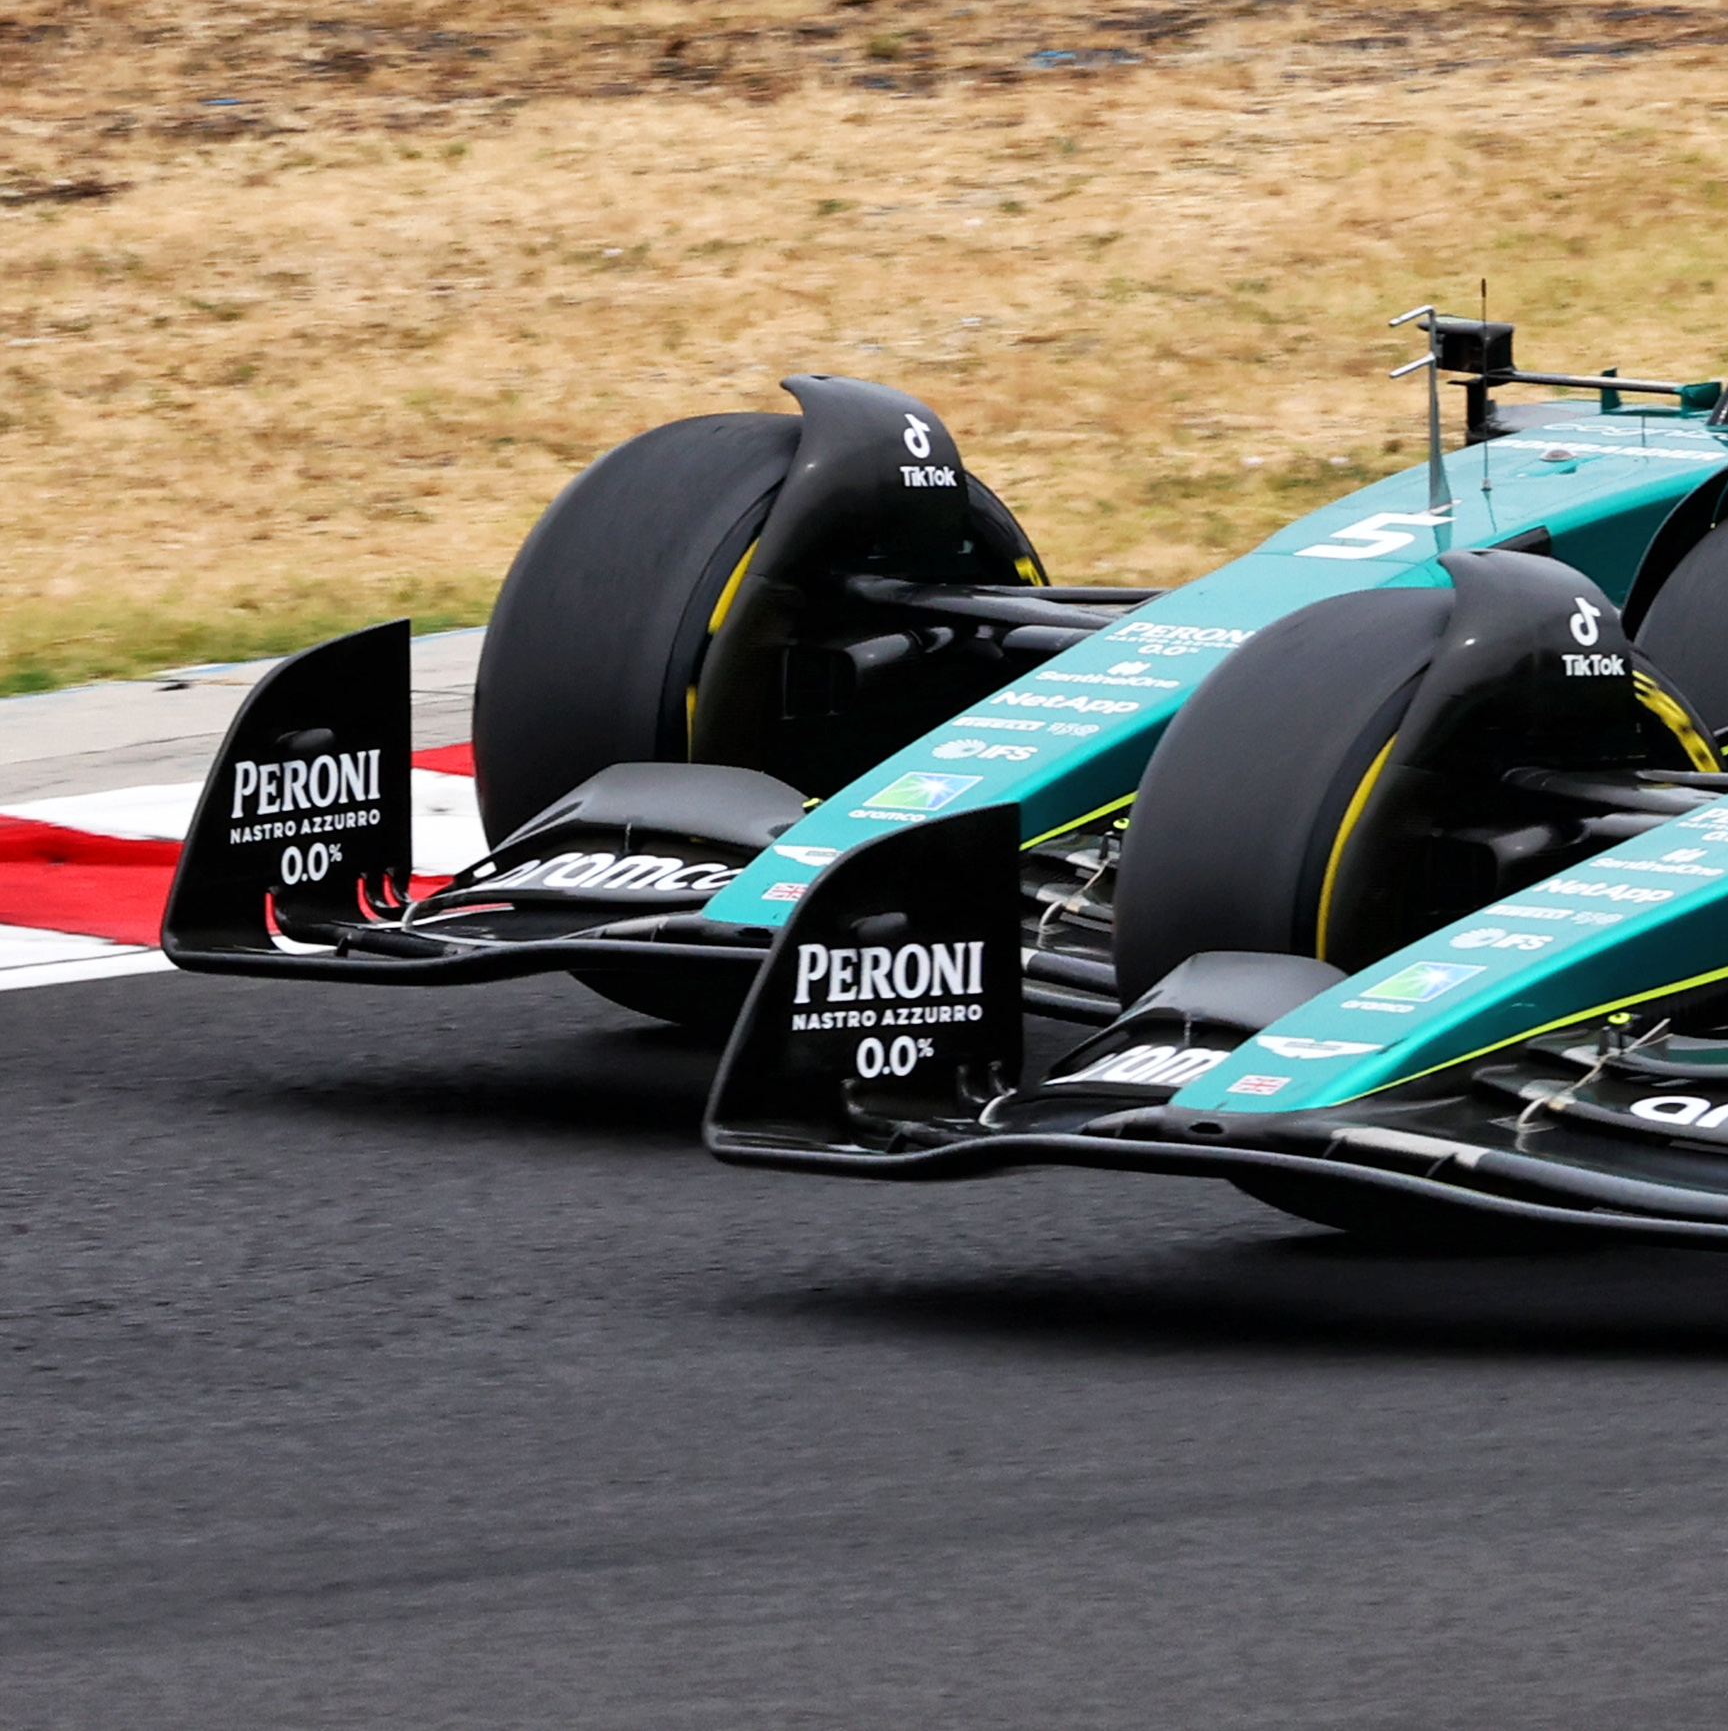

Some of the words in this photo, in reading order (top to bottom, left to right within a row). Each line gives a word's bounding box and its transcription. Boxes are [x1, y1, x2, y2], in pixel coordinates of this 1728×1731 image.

[900, 467, 957, 487] TikTok
[1293, 513, 1456, 559] 5
[1112, 621, 1256, 644] PERON
[1562, 654, 1625, 676] TikTok
[1034, 671, 1181, 689] SentinelOne
[989, 690, 1141, 715] NetApp
[976, 744, 1039, 761] IFS
[231, 749, 381, 819] PERONI
[229, 819, 297, 844] NASTRO
[301, 809, 382, 835] AZZURRO
[1532, 878, 1676, 904] NetApp
[1488, 932, 1555, 951] IFS
[793, 941, 985, 1006] PERONI
[791, 1008, 877, 1031] NASTRO
[881, 1003, 983, 1027] AZZURRO
